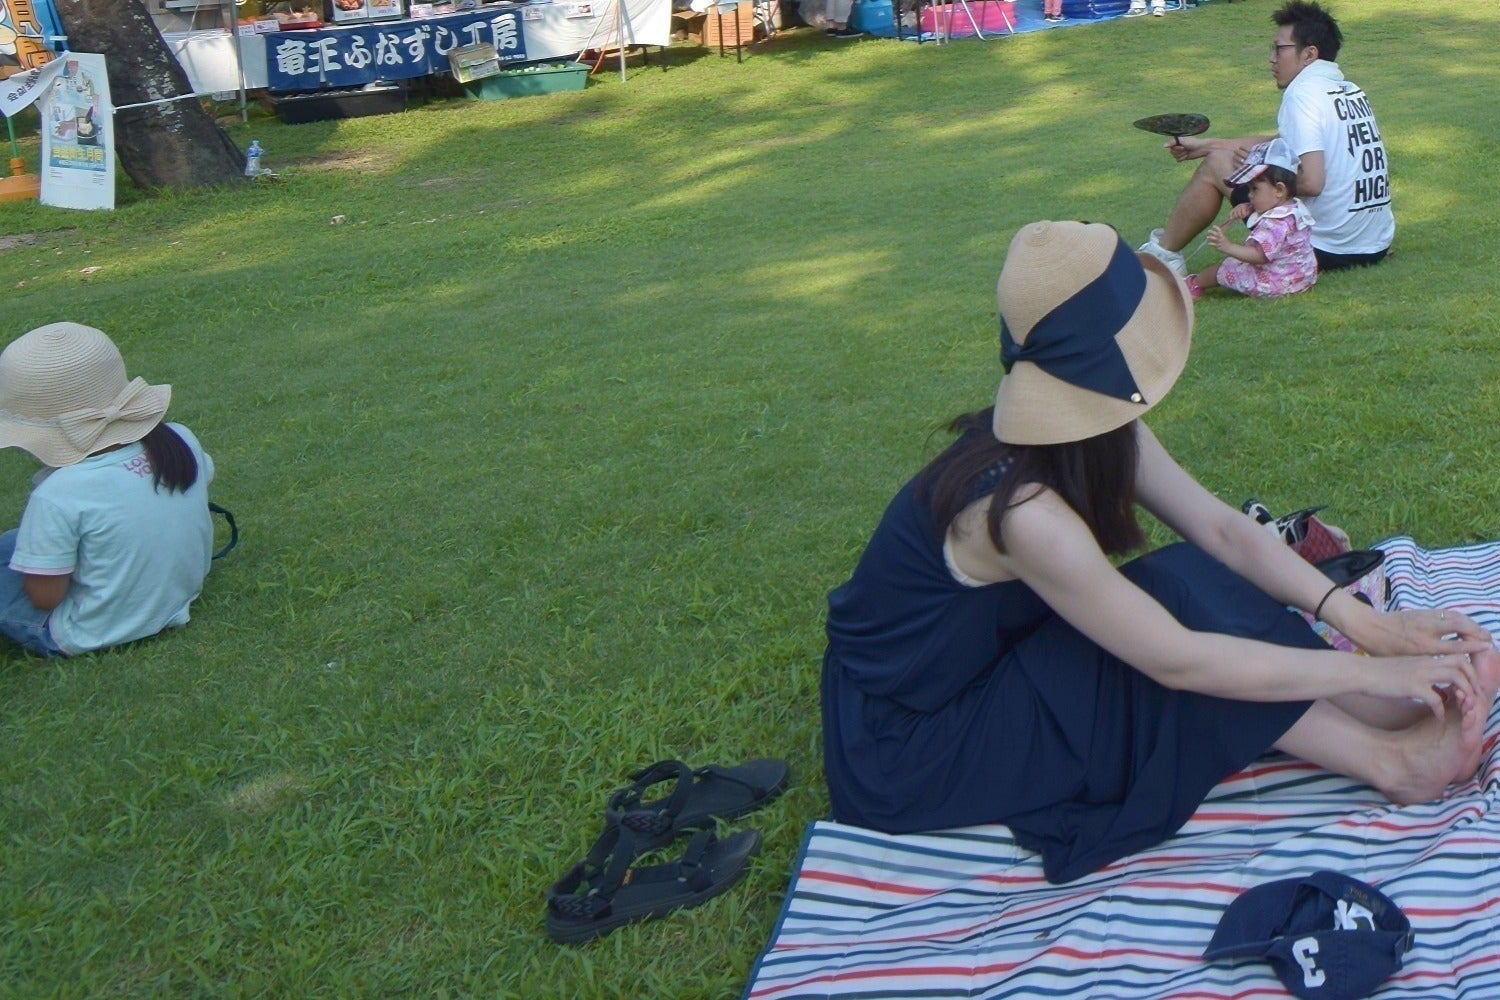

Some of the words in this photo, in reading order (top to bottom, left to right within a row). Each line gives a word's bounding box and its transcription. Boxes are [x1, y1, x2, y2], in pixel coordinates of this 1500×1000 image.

[275, 13, 518, 76] 竜王ふなずし工房
[1334, 96, 1372, 120] COM
[1362, 147, 1385, 173] OR
